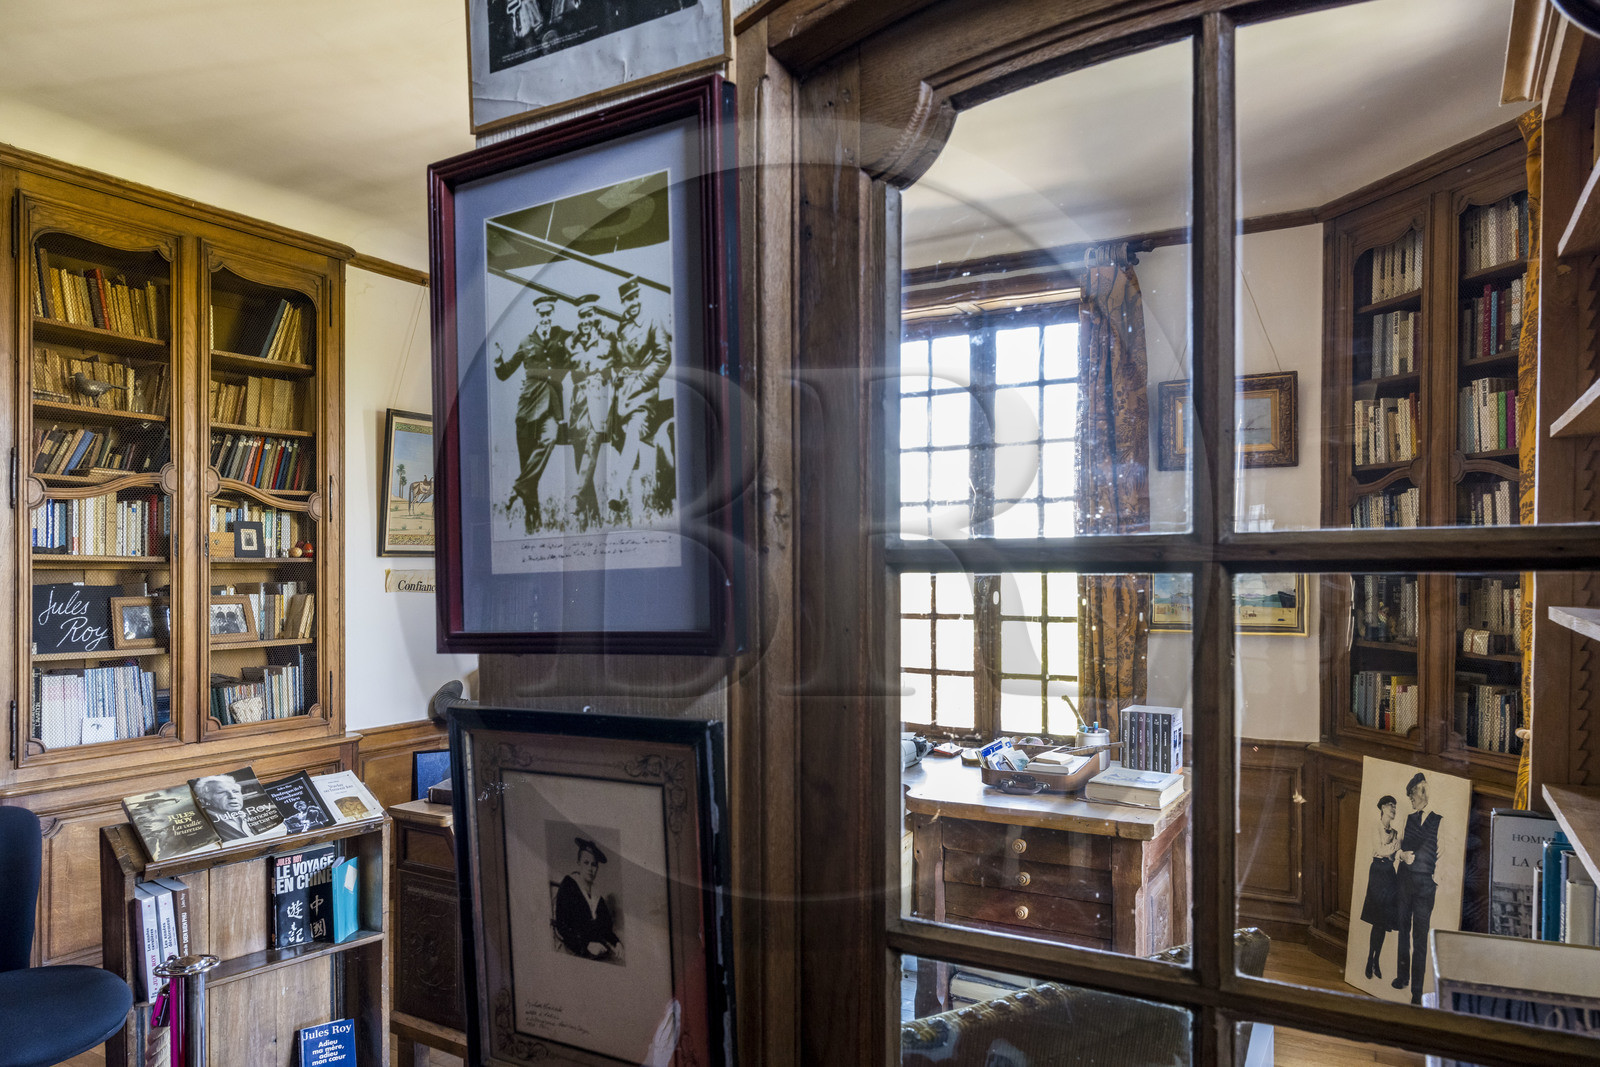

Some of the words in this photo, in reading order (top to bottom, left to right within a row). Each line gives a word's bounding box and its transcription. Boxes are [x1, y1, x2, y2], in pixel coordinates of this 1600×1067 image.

[56, 616, 108, 652] Roy
[167, 810, 196, 822] JULES
[213, 810, 246, 823] Jules
[245, 803, 271, 816] Roy
[174, 817, 193, 825] ROY
[182, 819, 202, 830] vallée
[247, 814, 279, 827] barbares
[174, 825, 204, 837] heureuse
[276, 857, 291, 867] JULES
[292, 854, 303, 863] ROY
[1511, 856, 1530, 868] LA
[276, 865, 291, 880] LE
[292, 854, 335, 877] VOYAGE
[276, 876, 294, 895] EN
[296, 867, 333, 890] CHINE
[302, 1029, 330, 1041] Jules
[331, 1024, 352, 1035] Roy
[318, 1039, 338, 1048] Adieu
[324, 1044, 345, 1052] mère,
[318, 1051, 339, 1060] adieu
[311, 1058, 327, 1067] mon
